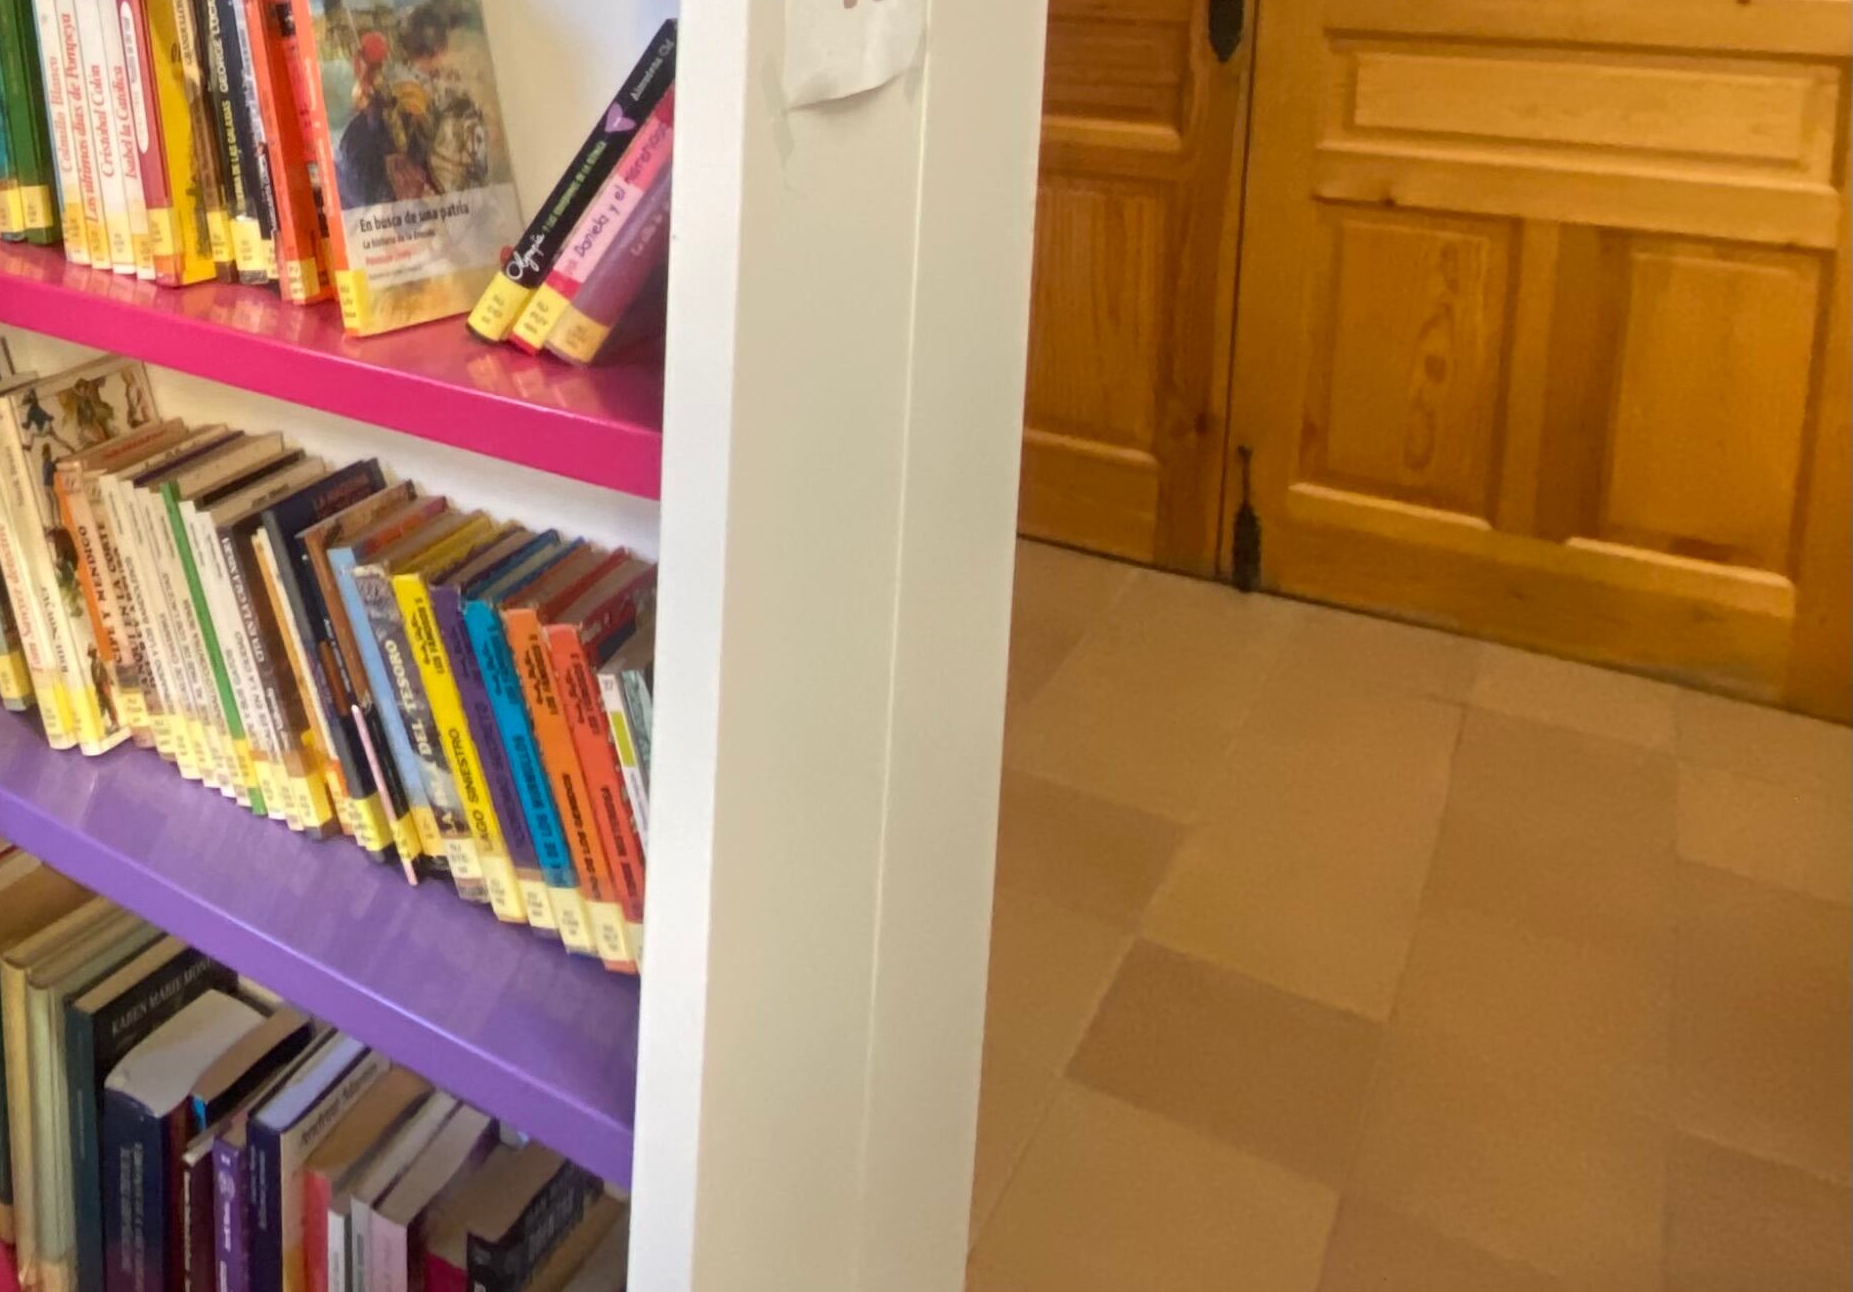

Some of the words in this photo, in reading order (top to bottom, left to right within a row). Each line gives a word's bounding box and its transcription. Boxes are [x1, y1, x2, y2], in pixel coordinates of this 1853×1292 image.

[56, 11, 81, 81] Pompeya
[212, 37, 229, 93] GEORGE
[66, 83, 82, 102] de
[360, 218, 373, 233] En
[375, 214, 402, 230] busca
[404, 211, 418, 225] de
[419, 208, 438, 222] una
[440, 202, 470, 223] patria
[574, 214, 609, 258] Daniela
[615, 185, 626, 202] el
[76, 524, 106, 602] MENDIGO
[382, 636, 418, 713] TESORO
[410, 717, 432, 757] DEL
[447, 726, 479, 803] SINIESTRO
